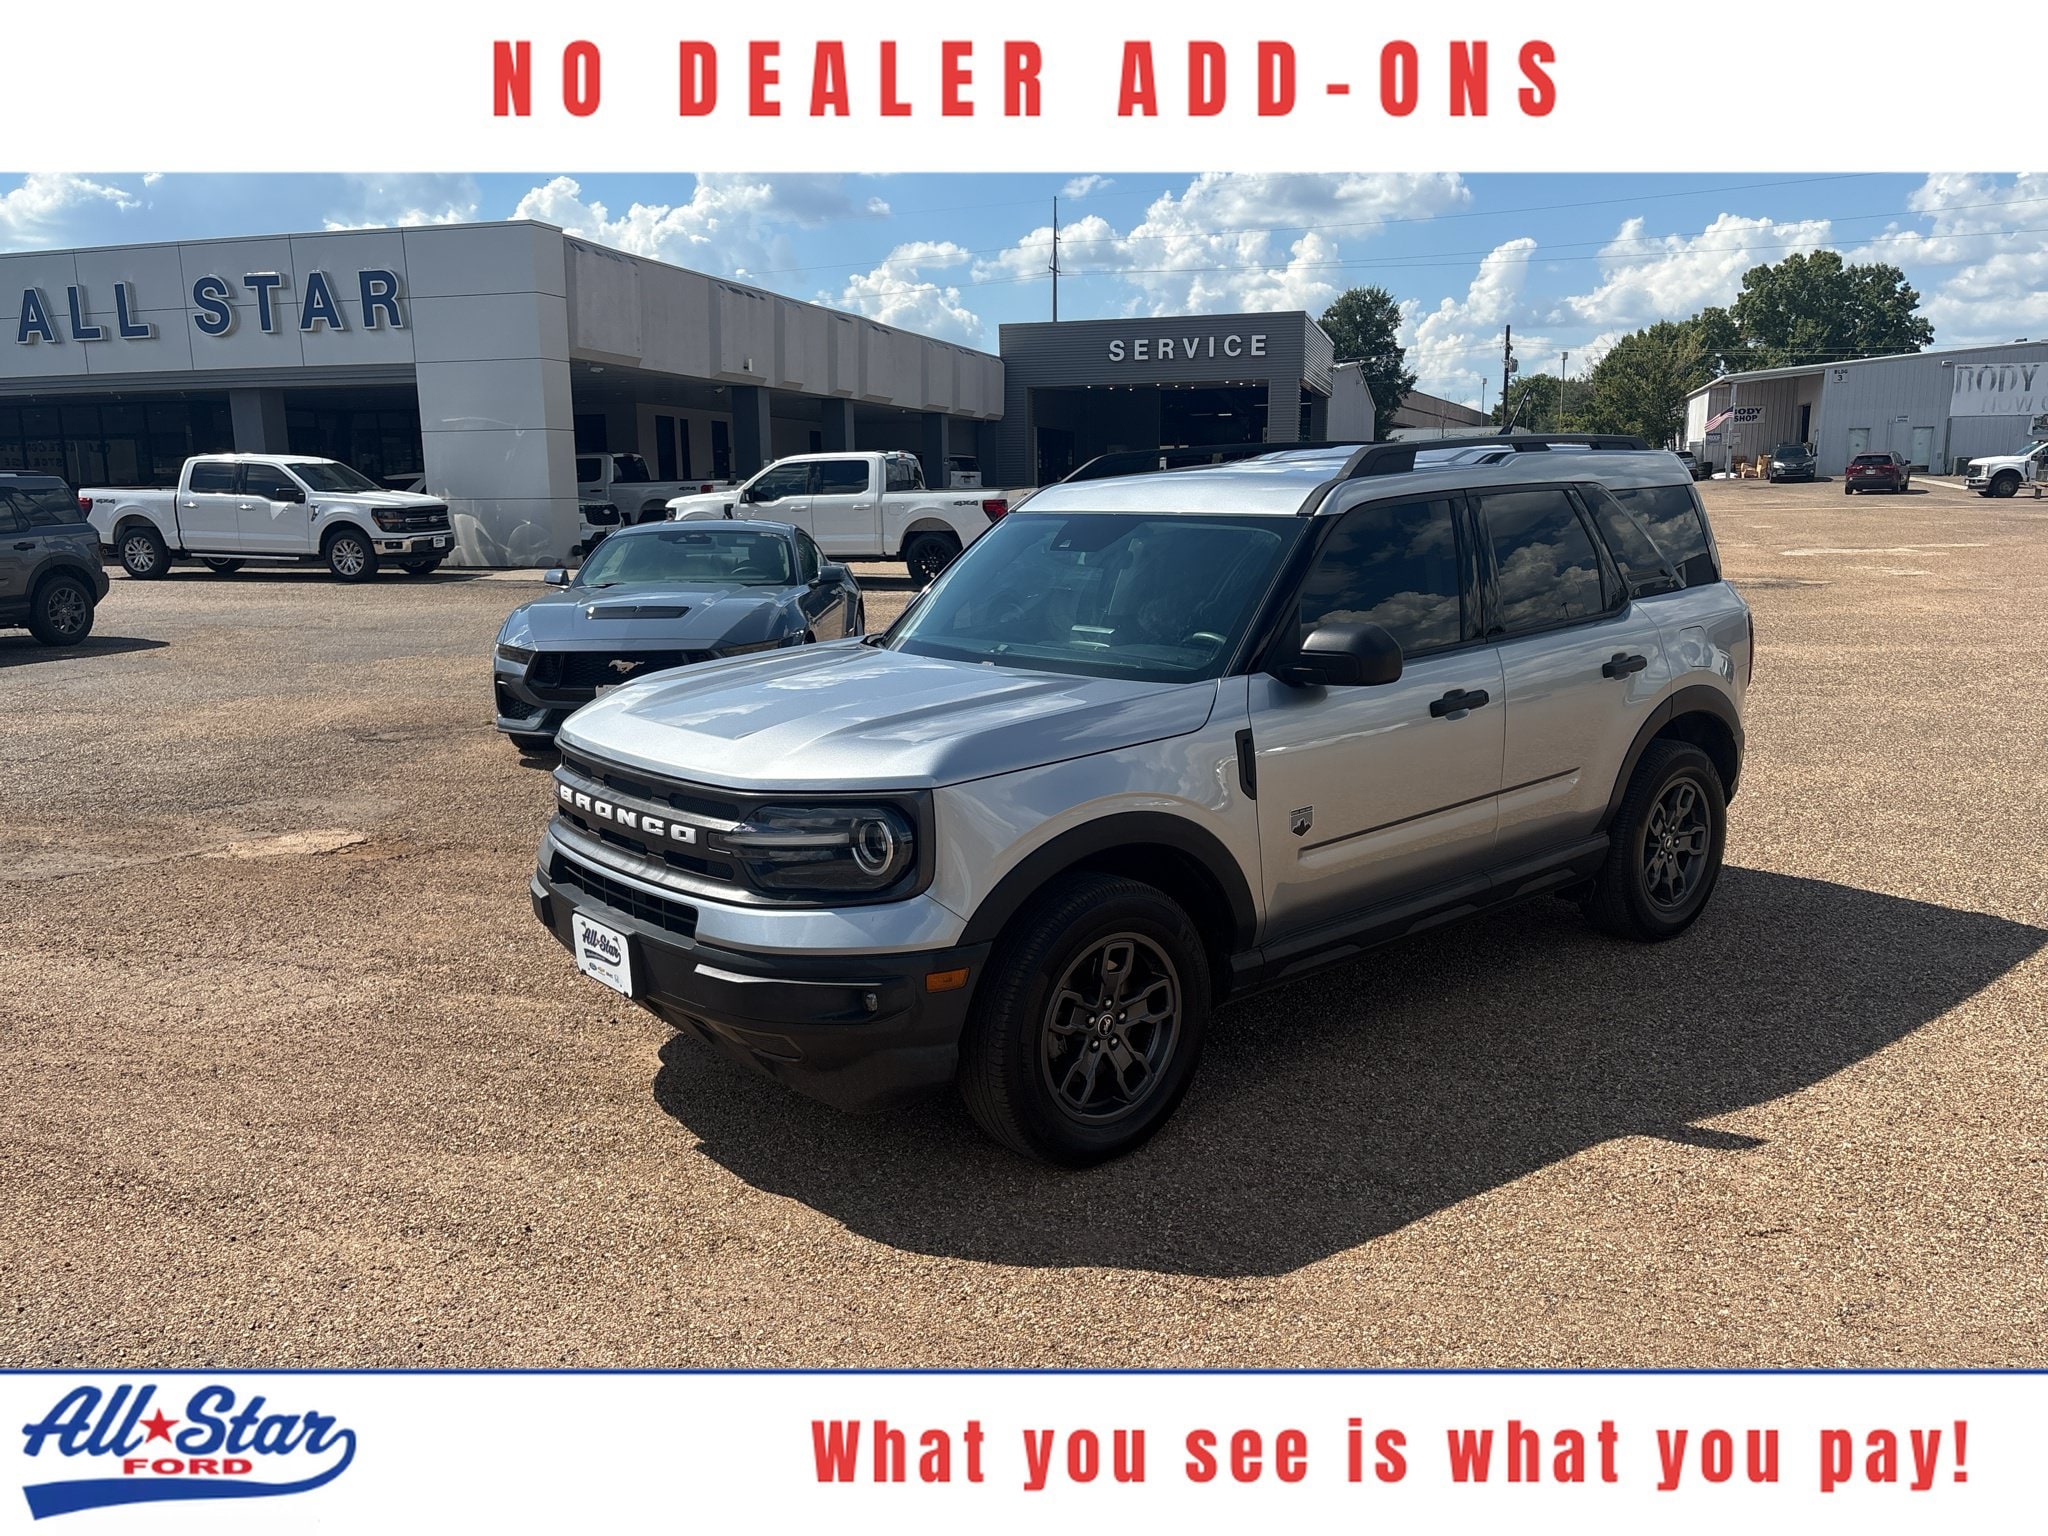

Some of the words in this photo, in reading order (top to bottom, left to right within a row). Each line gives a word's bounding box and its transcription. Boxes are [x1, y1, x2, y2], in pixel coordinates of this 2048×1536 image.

[15, 281, 154, 345] ALL
[191, 269, 408, 337] STAR
[1108, 335, 1267, 361] SERVICE
[1734, 414, 1758, 422] SHOP
[559, 784, 697, 845] BRONCO
